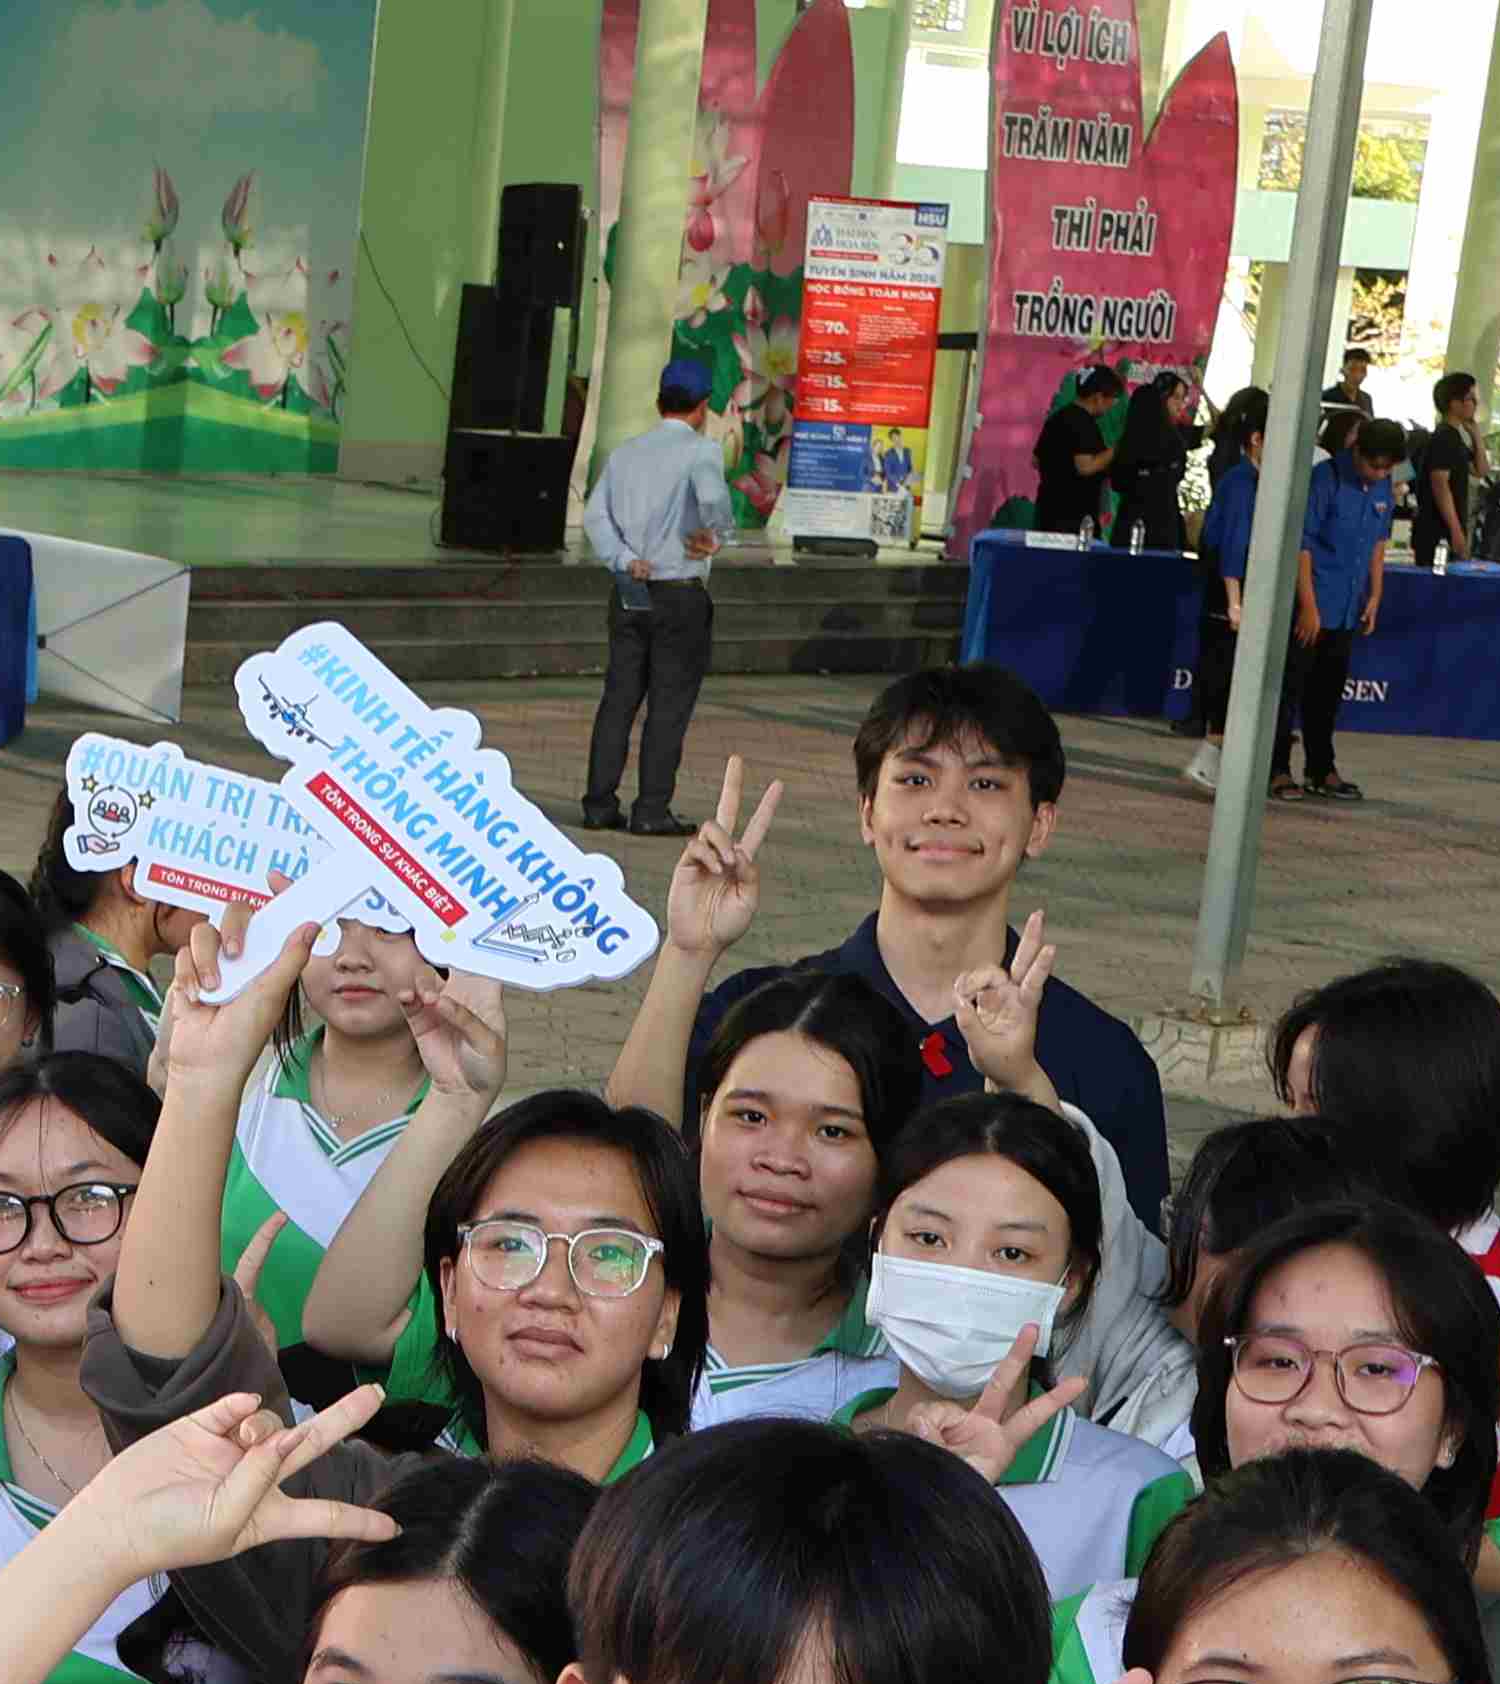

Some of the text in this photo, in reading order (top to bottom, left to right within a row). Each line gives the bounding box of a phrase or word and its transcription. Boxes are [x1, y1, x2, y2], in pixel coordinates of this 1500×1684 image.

[1010, 5, 1131, 70] VÌ LỢI ÍCH
[1004, 113, 1133, 168] TRĂM NĂM
[1052, 195, 1157, 257] THÌ PHẢI
[1014, 280, 1176, 344] TRỒNG NGƯỜI
[79, 742, 259, 825] #QUẢN TRỊ
[297, 642, 634, 956] #KINH TẾ HÀNG KHÔNG
[147, 808, 258, 876] KHÁCH
[318, 782, 344, 808] TÔN
[340, 803, 381, 845] TRỌNG
[377, 840, 400, 866] SỰ
[397, 858, 430, 896] KHÁC
[424, 886, 454, 917] BIỆT
[327, 734, 522, 922] THÔNG MINH
[159, 868, 191, 887] TÔN
[193, 877, 229, 900] TRỌNG
